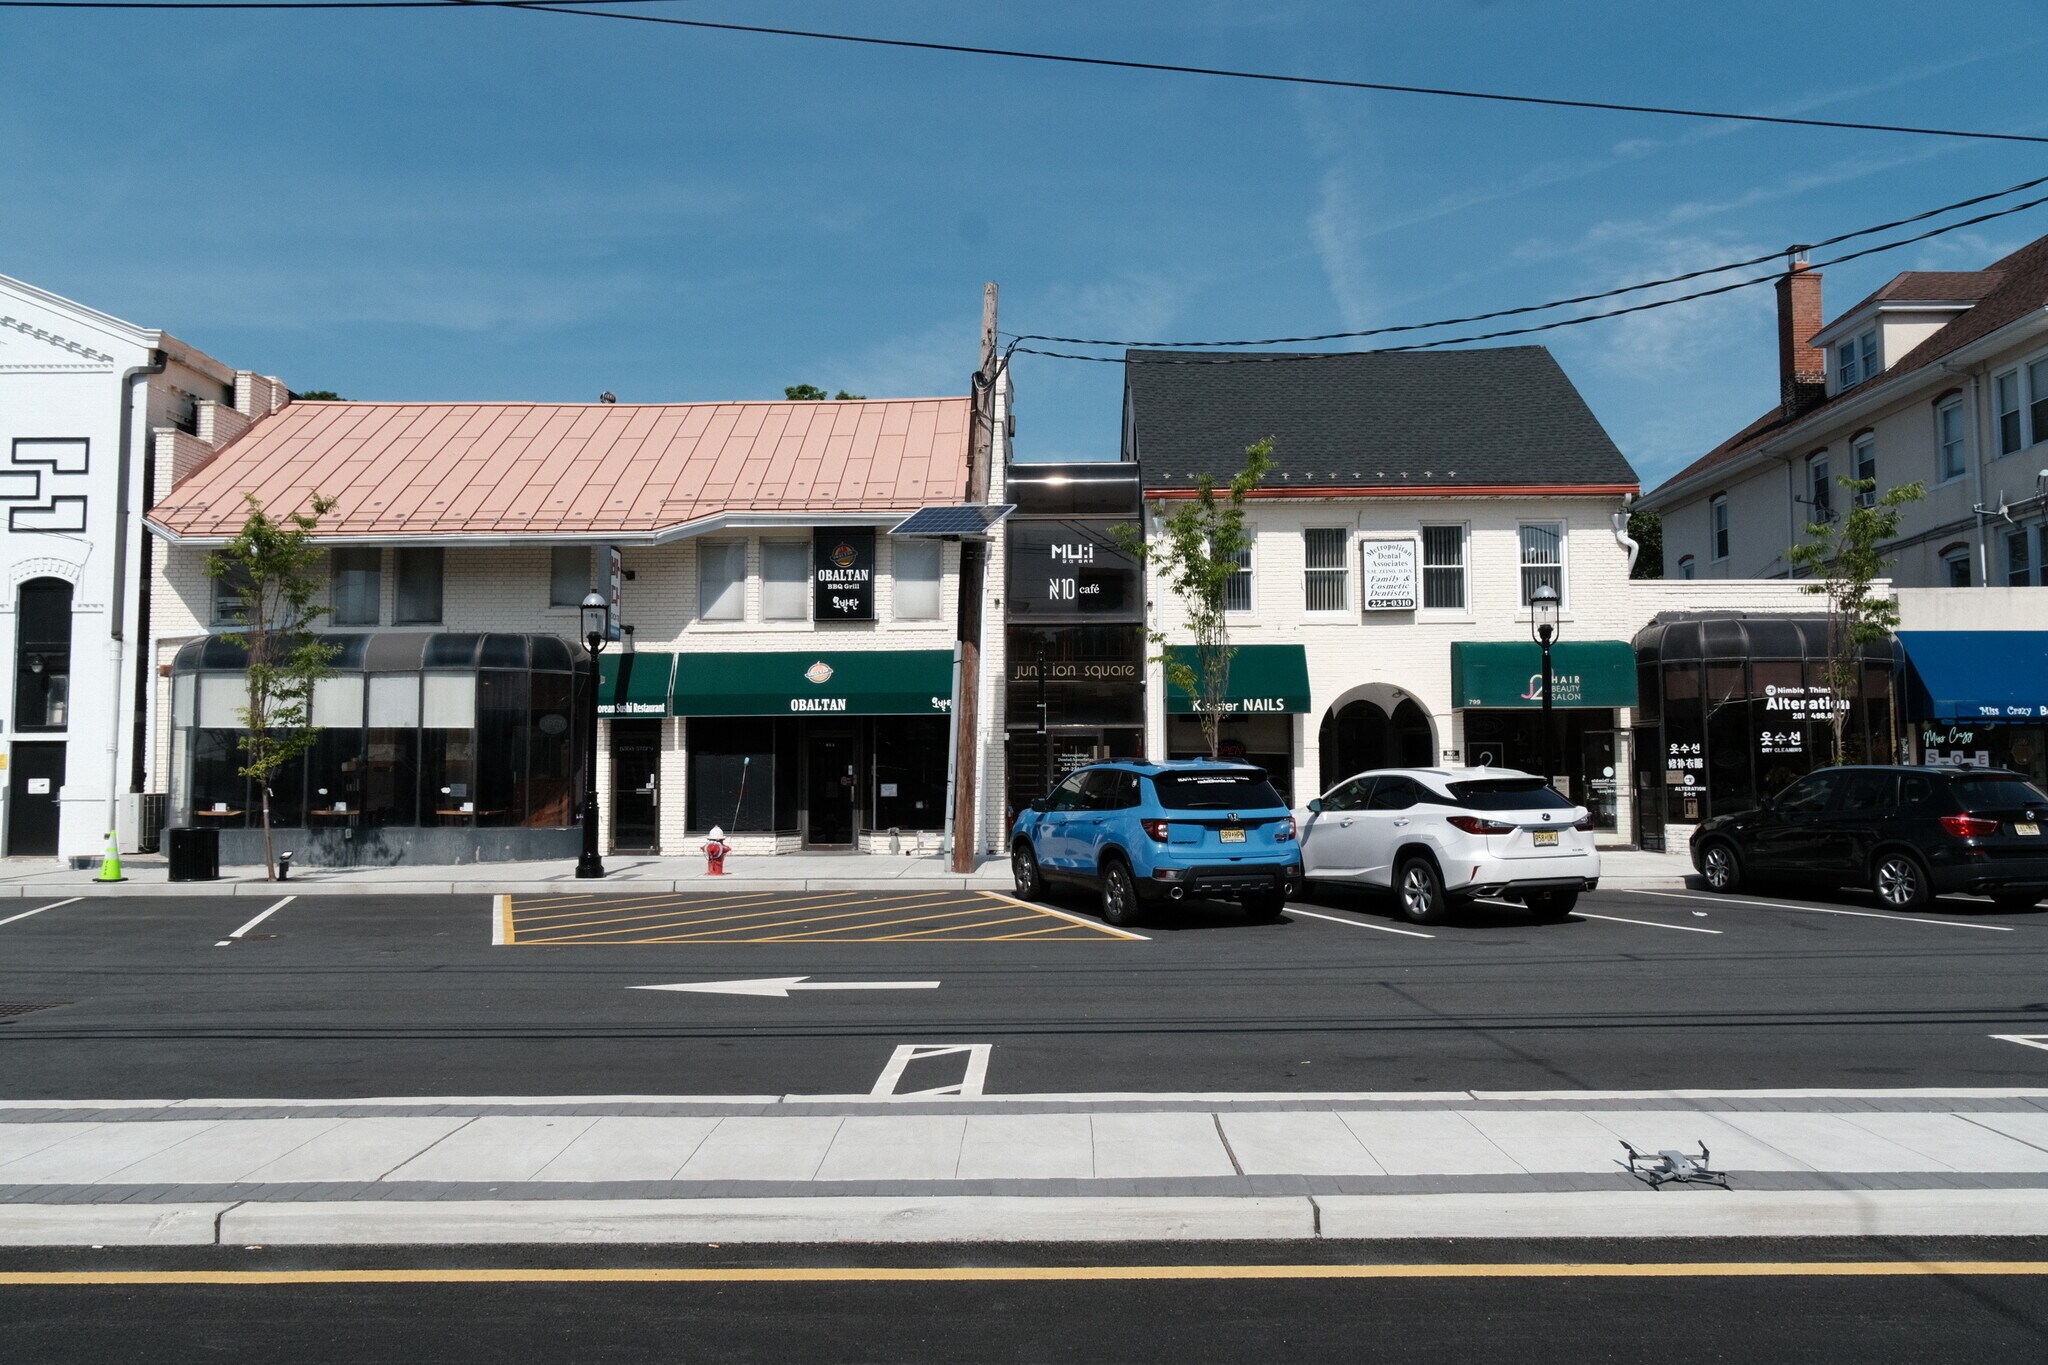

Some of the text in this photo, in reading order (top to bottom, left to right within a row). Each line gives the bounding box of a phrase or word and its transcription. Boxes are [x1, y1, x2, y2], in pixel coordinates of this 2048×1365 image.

[1366, 544, 1412, 557] Metropolitan
[818, 569, 869, 582] OBALTAN
[1370, 575, 1399, 584] Family
[1079, 583, 1100, 594] café
[832, 596, 859, 613] 오발탄
[1014, 662, 1135, 679] junion square
[1551, 675, 1580, 684] HAIR
[597, 702, 665, 713] orean Sushi Restaurant
[790, 698, 846, 711] OBALTAN
[1243, 698, 1284, 711] NAILS
[1980, 706, 2000, 716] Miss
[2007, 706, 2032, 716] Crazy
[1760, 731, 1800, 746] 옷수선
[1923, 726, 1974, 747] Miss Crazy
[1669, 743, 1700, 754] 옷수선
